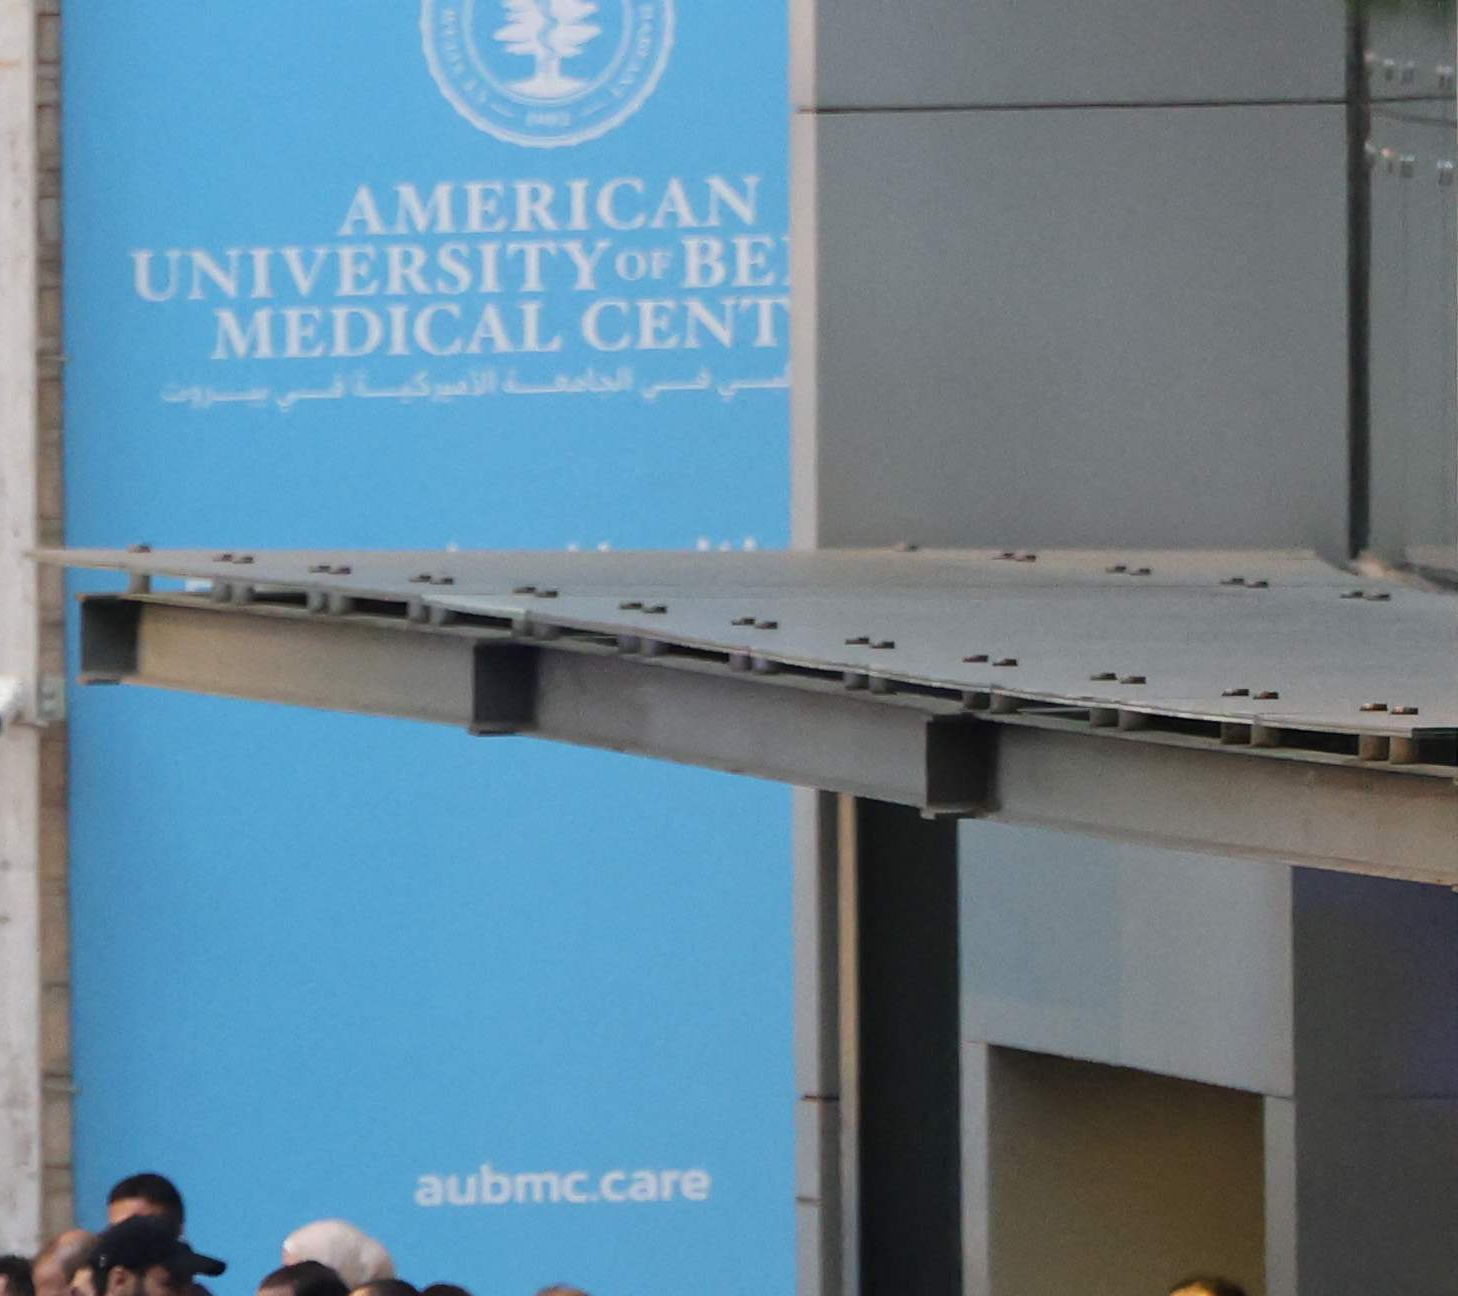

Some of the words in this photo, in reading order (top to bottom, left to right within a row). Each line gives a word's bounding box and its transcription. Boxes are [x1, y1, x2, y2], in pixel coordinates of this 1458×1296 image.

[336, 174, 762, 237] AMERICAN
[130, 239, 611, 302] UNIVERSITY
[614, 249, 673, 280] OF
[210, 302, 562, 361] MEDICAL
[414, 1161, 712, 1207] aubmc.care
